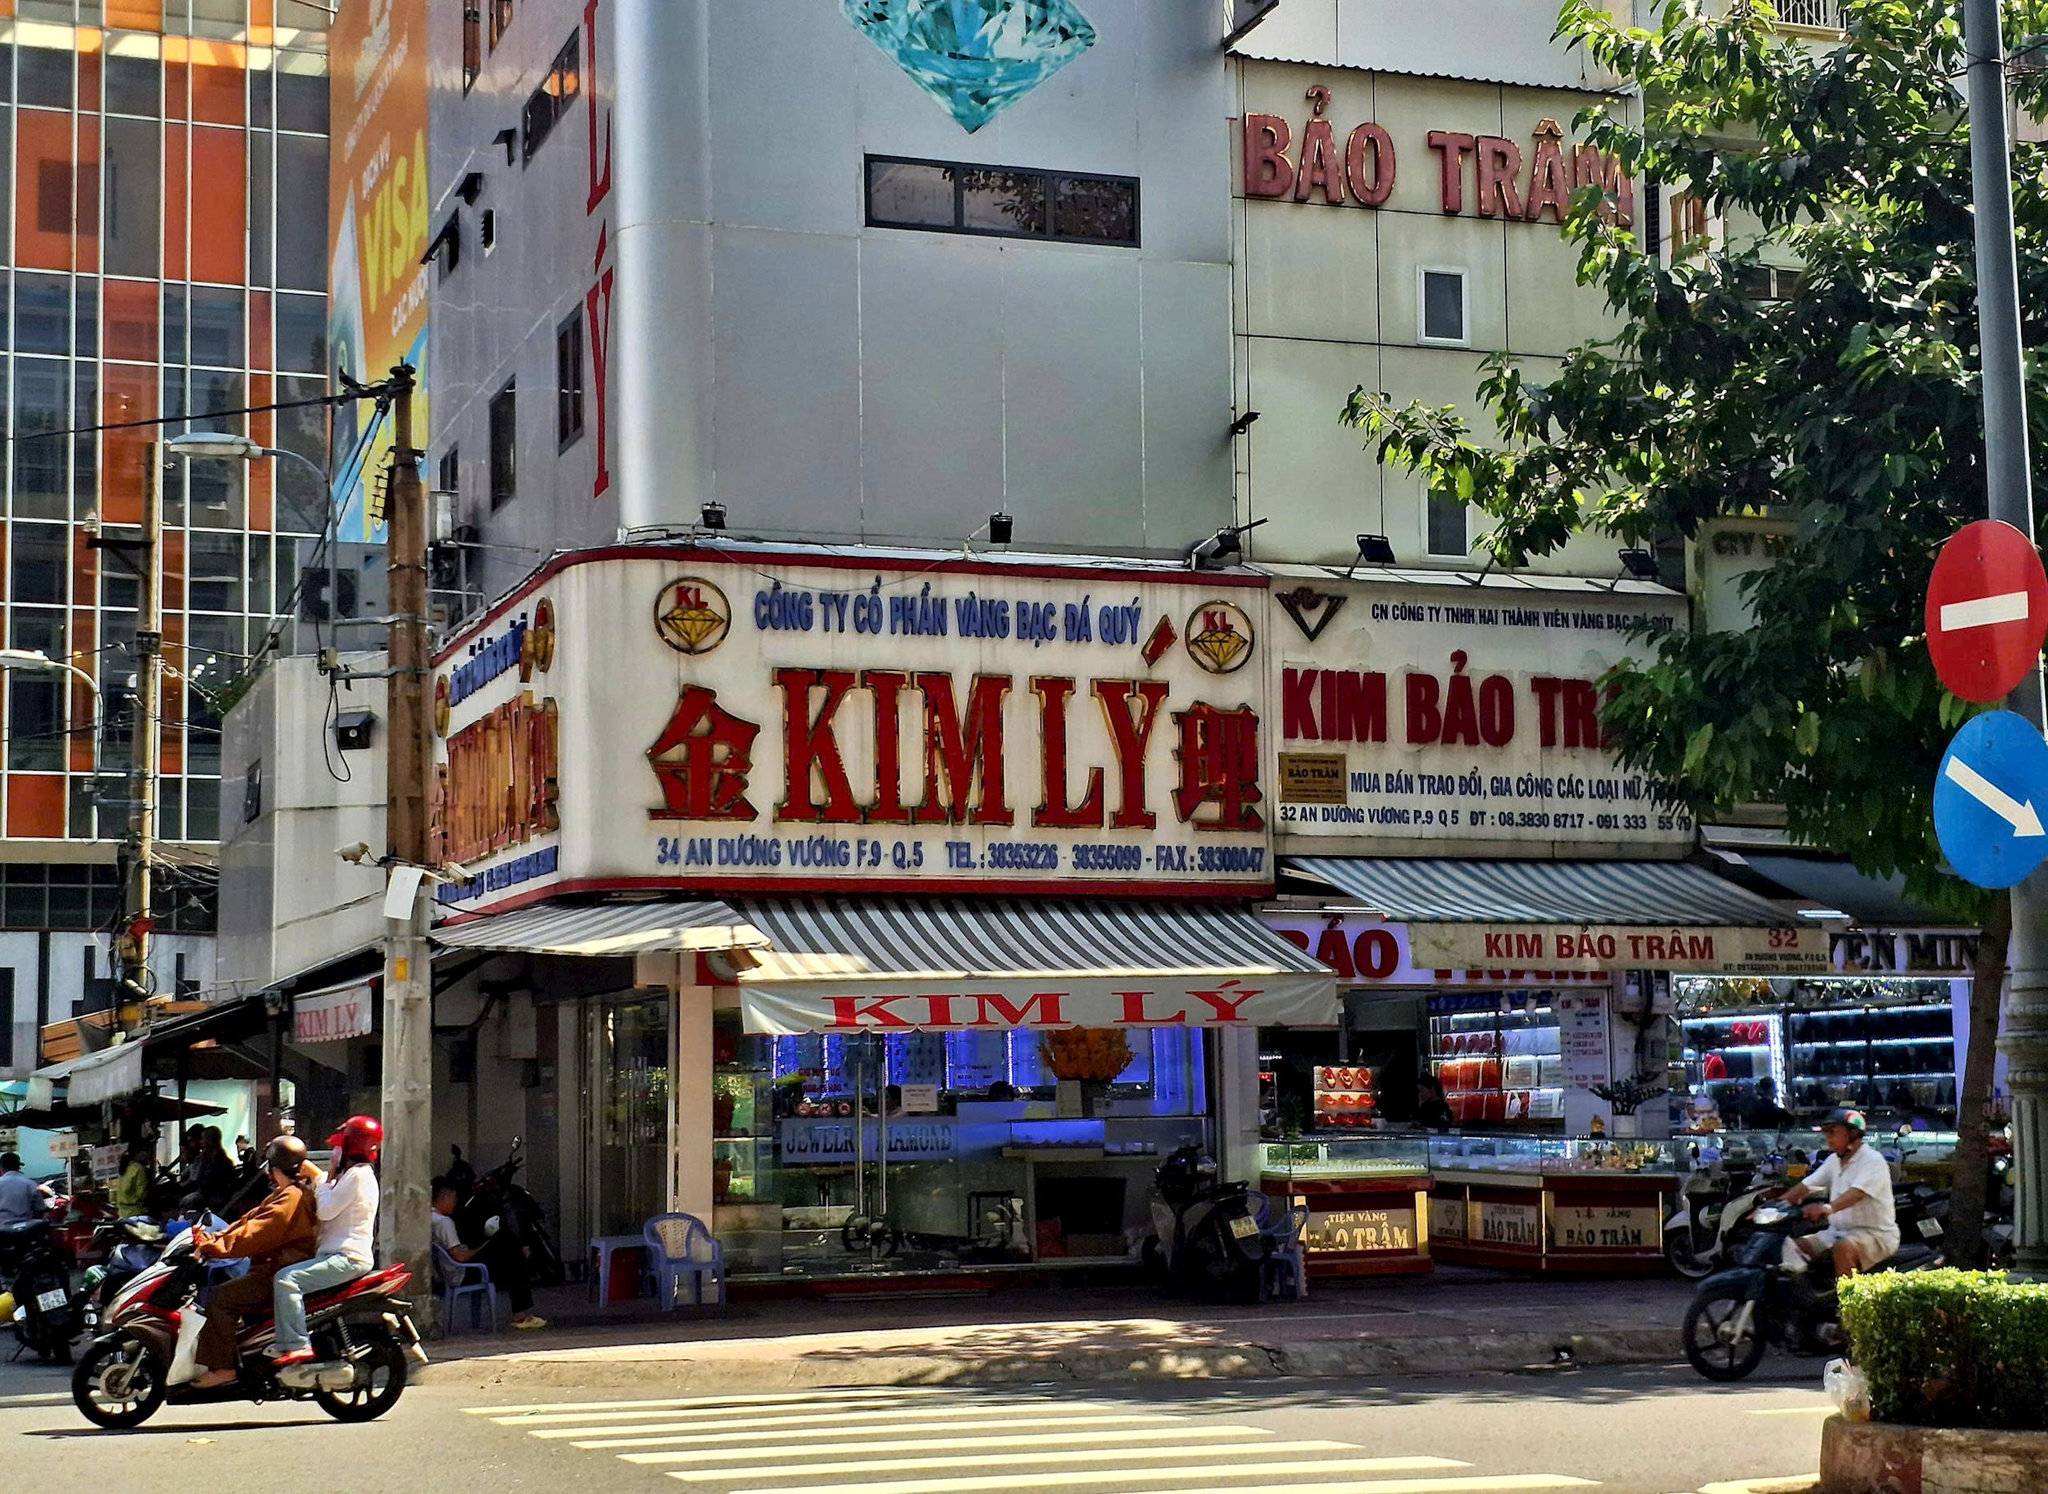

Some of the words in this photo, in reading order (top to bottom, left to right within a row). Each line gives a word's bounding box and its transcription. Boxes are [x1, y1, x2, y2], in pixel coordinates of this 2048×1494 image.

[1244, 84, 1397, 207] BẢO
[1428, 117, 1634, 226] TRÂM
[363, 127, 429, 314] VISA
[676, 585, 709, 609] KL
[754, 580, 813, 631] CÔNG
[819, 593, 849, 633] TY
[853, 575, 884, 634] CỔ
[890, 582, 948, 637] PHẦN
[955, 591, 1010, 639] VÀNG
[1016, 602, 1057, 647] BẠC
[1064, 595, 1092, 643] ĐÁ
[1100, 597, 1142, 645] QUÝ
[1203, 611, 1234, 632] KL
[1372, 603, 1389, 622] CN
[1392, 601, 1425, 622] CÔNG
[1427, 605, 1442, 623] TY
[1444, 606, 1477, 625] TNHH
[1478, 607, 1499, 626] HAI
[1502, 607, 1541, 628] THÀNH
[1543, 608, 1570, 629] VIÊN
[1573, 609, 1604, 631] VÀNG
[1607, 613, 1630, 633] BẠC
[1283, 668, 1387, 743] KIM
[1405, 649, 1515, 748] BẢO
[1531, 667, 1622, 750] TR
[772, 667, 1014, 827] KIM
[1029, 614, 1178, 831] LÝ
[647, 684, 760, 822] 金
[1350, 772, 1381, 794] MUA
[1385, 768, 1414, 796] BÁN
[1417, 774, 1455, 797] TRAO
[1490, 776, 1512, 799] GIA
[1516, 772, 1553, 799] CÔNG
[1556, 774, 1585, 800] CÁC
[1589, 778, 1619, 803] LOẠI
[1622, 775, 1642, 800] NỮ
[1280, 806, 1297, 821] 32
[1300, 807, 1318, 822] AN
[1322, 805, 1365, 824] DƯƠNG
[1368, 806, 1410, 825] VƯƠNG
[1413, 809, 1434, 825] P.9
[1499, 811, 1550, 828] 08.3830
[1553, 813, 1585, 829] 8717
[1596, 814, 1620, 829] 091
[1623, 814, 1647, 830] 333
[1657, 816, 1673, 831] 55
[658, 837, 680, 866] 34
[685, 838, 712, 867] AN
[718, 834, 782, 867] DƯƠNG
[787, 834, 850, 868] VƯƠNG
[857, 839, 882, 868] F.9
[893, 841, 923, 870] Q.5
[1484, 932, 1543, 959] KIM
[1556, 924, 1616, 960] BẢO
[1627, 929, 1714, 961] TRÂM
[1768, 928, 1799, 948] 32
[823, 991, 1072, 1028] KIM
[1111, 980, 1265, 1026] LÝ
[296, 1008, 329, 1039] KIM
[786, 1124, 856, 1153] JEWELR
[1328, 1211, 1354, 1224] TIỆM
[1357, 1210, 1388, 1222] VÀNG
[1482, 1211, 1505, 1241] BẢO
[1353, 1221, 1409, 1250] TRÂM
[1566, 1222, 1596, 1245] BẢO
[1600, 1223, 1642, 1245] TRÂM
